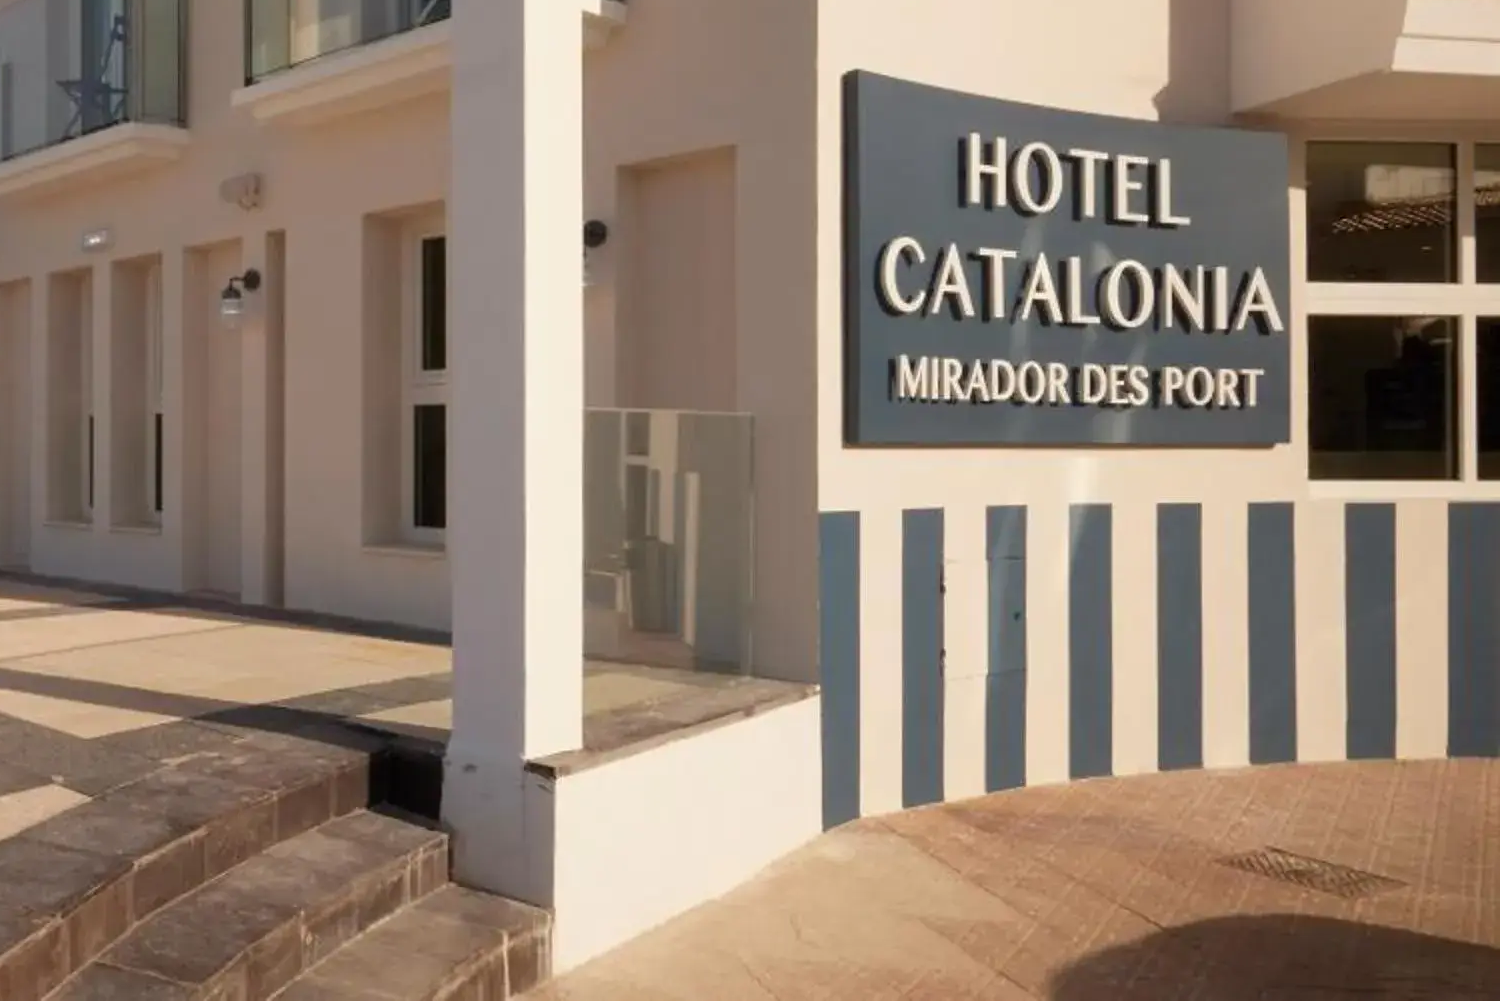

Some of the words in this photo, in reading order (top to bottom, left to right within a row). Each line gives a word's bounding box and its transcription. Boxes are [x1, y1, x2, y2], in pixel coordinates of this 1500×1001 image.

[965, 132, 1191, 226] HOTEL
[880, 236, 1284, 332] CATALONIA
[897, 354, 1070, 405] MIRADOR
[1082, 363, 1149, 407] DES
[1164, 366, 1264, 407] PORT
